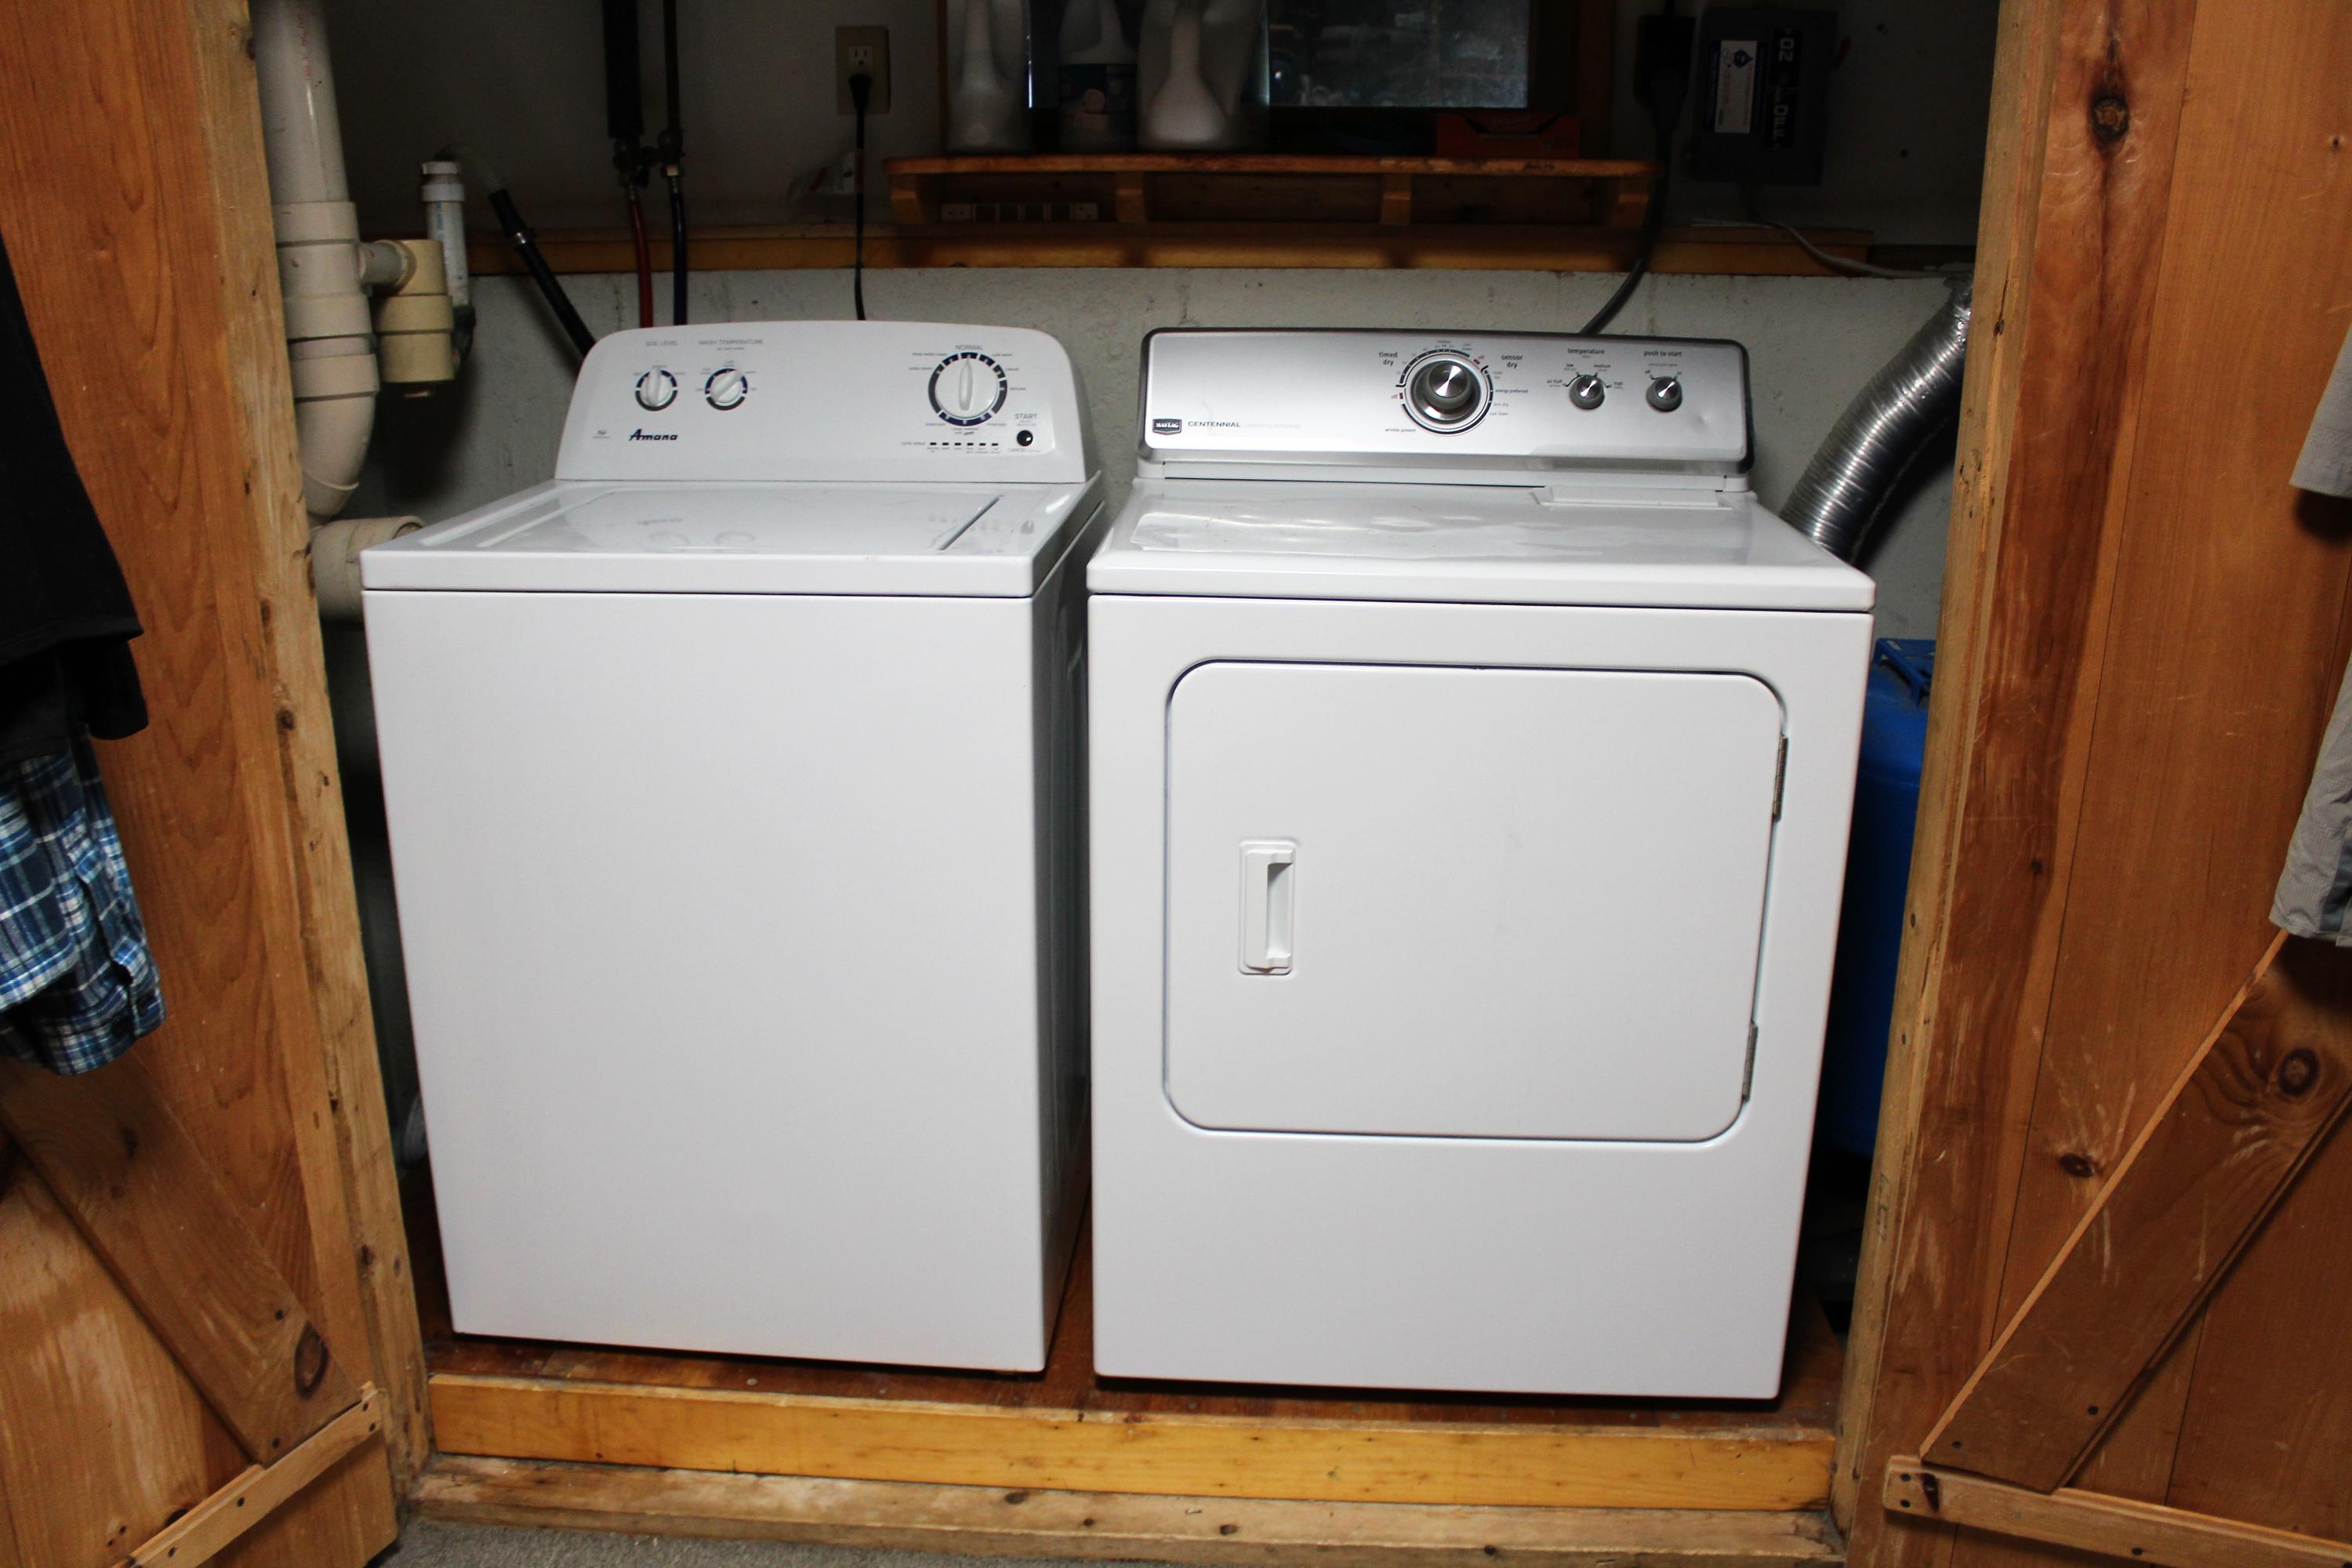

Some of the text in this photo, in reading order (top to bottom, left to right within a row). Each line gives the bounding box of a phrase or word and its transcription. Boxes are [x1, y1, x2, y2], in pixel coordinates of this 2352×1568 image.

[1382, 358, 1395, 367] dry
[1506, 361, 1518, 369] dry
[628, 428, 679, 441] Amana
